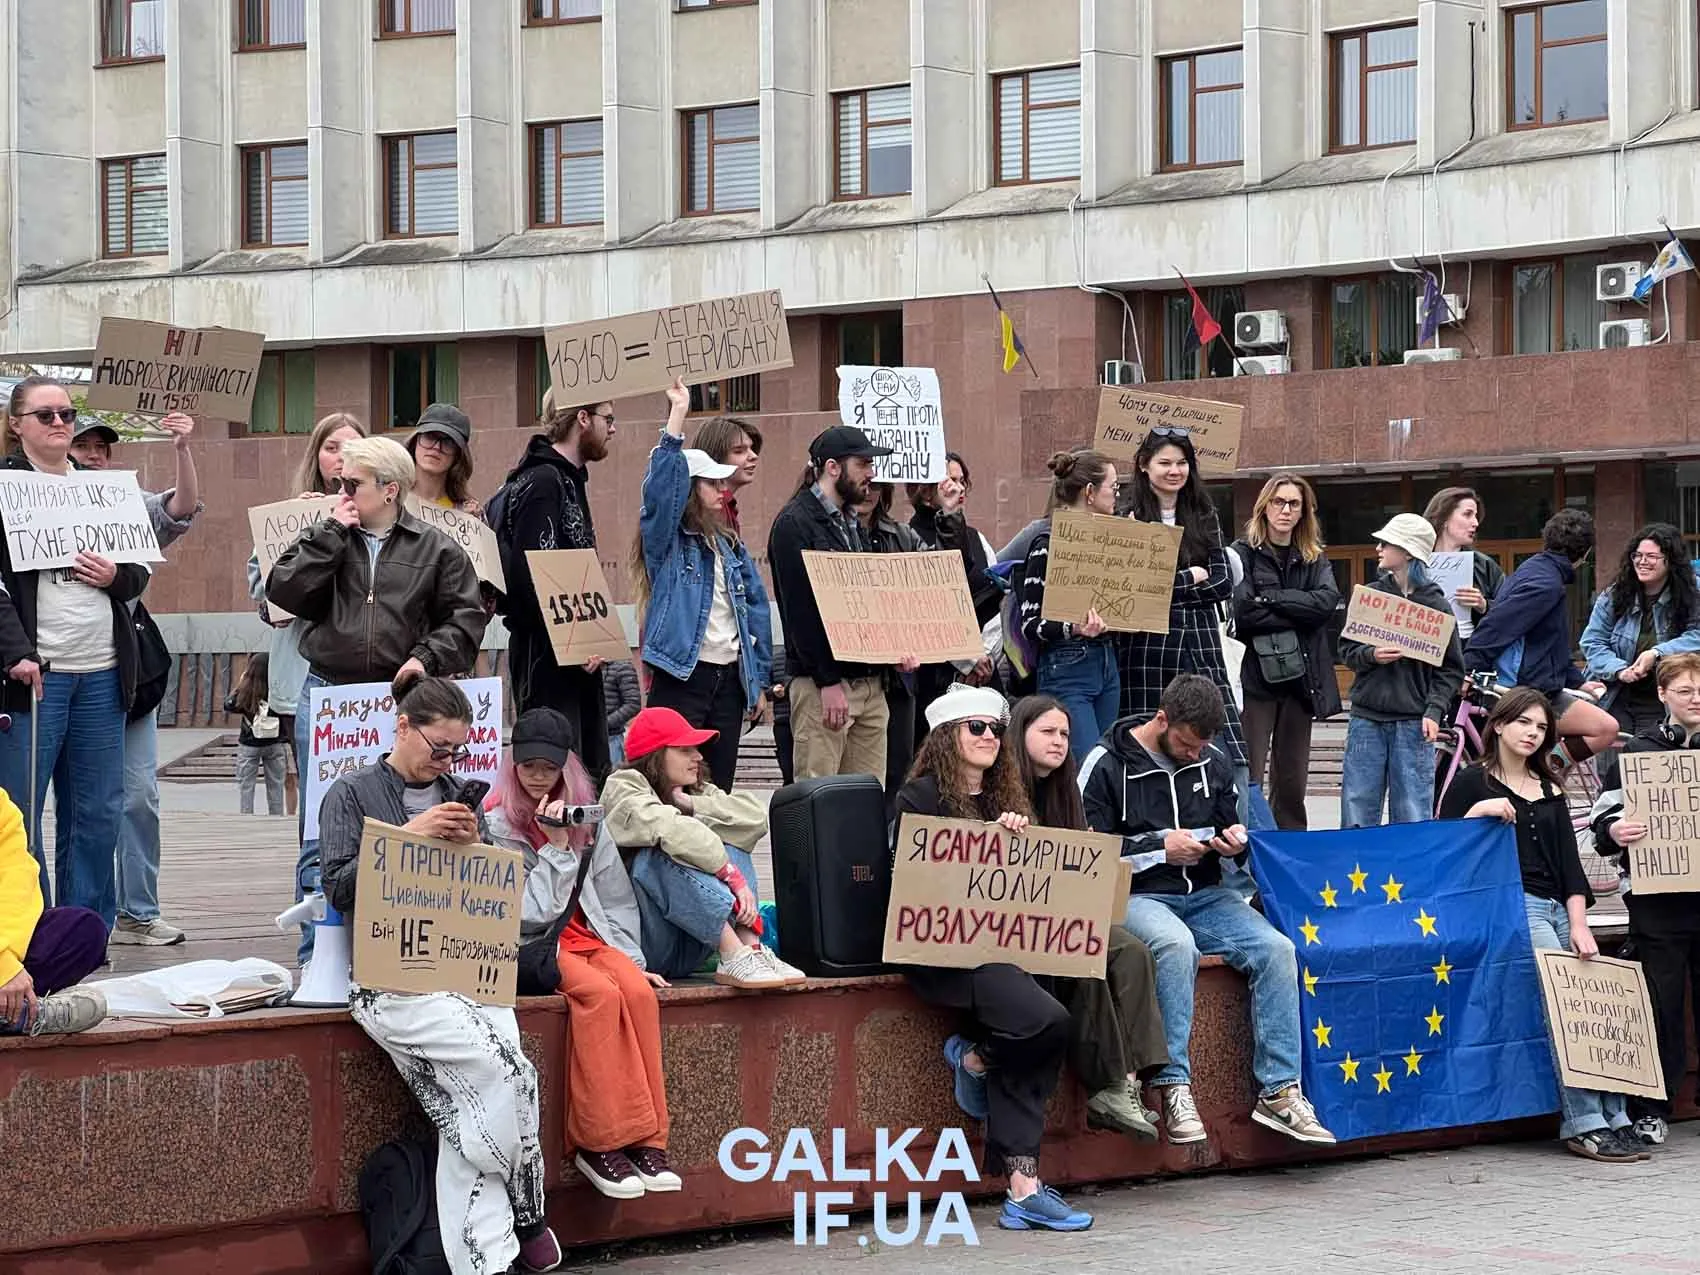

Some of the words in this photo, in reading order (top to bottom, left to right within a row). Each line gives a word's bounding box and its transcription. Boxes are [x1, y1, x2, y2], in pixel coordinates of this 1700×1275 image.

[654, 291, 782, 340] ЛЕГАЛІЗАЦІЯ
[551, 331, 619, 389] 15150
[666, 324, 780, 376] ДЕРИБАНУ
[854, 402, 866, 425] Я
[906, 404, 940, 425] ПРОТИ
[0, 480, 85, 512] ПОМІНЯЙТЕ
[9, 527, 70, 561] ТХНЕ
[73, 523, 156, 554] БОЛОТАМИ
[549, 591, 608, 625] 15150
[1624, 757, 1652, 785] НЕ
[1626, 790, 1638, 817] У
[1648, 787, 1681, 813] НАС
[374, 837, 387, 873] Я
[400, 842, 516, 893] ПРОЧИТАЛА
[909, 828, 928, 862] Я
[930, 828, 1004, 867] САМА
[1008, 836, 1103, 880] ВИРІШУ,
[1636, 846, 1690, 879] НАШУ
[967, 868, 1051, 905] КОЛИ
[400, 917, 434, 959] НЕ
[896, 905, 1104, 956] РОЗЛУЧАТИСЬ
